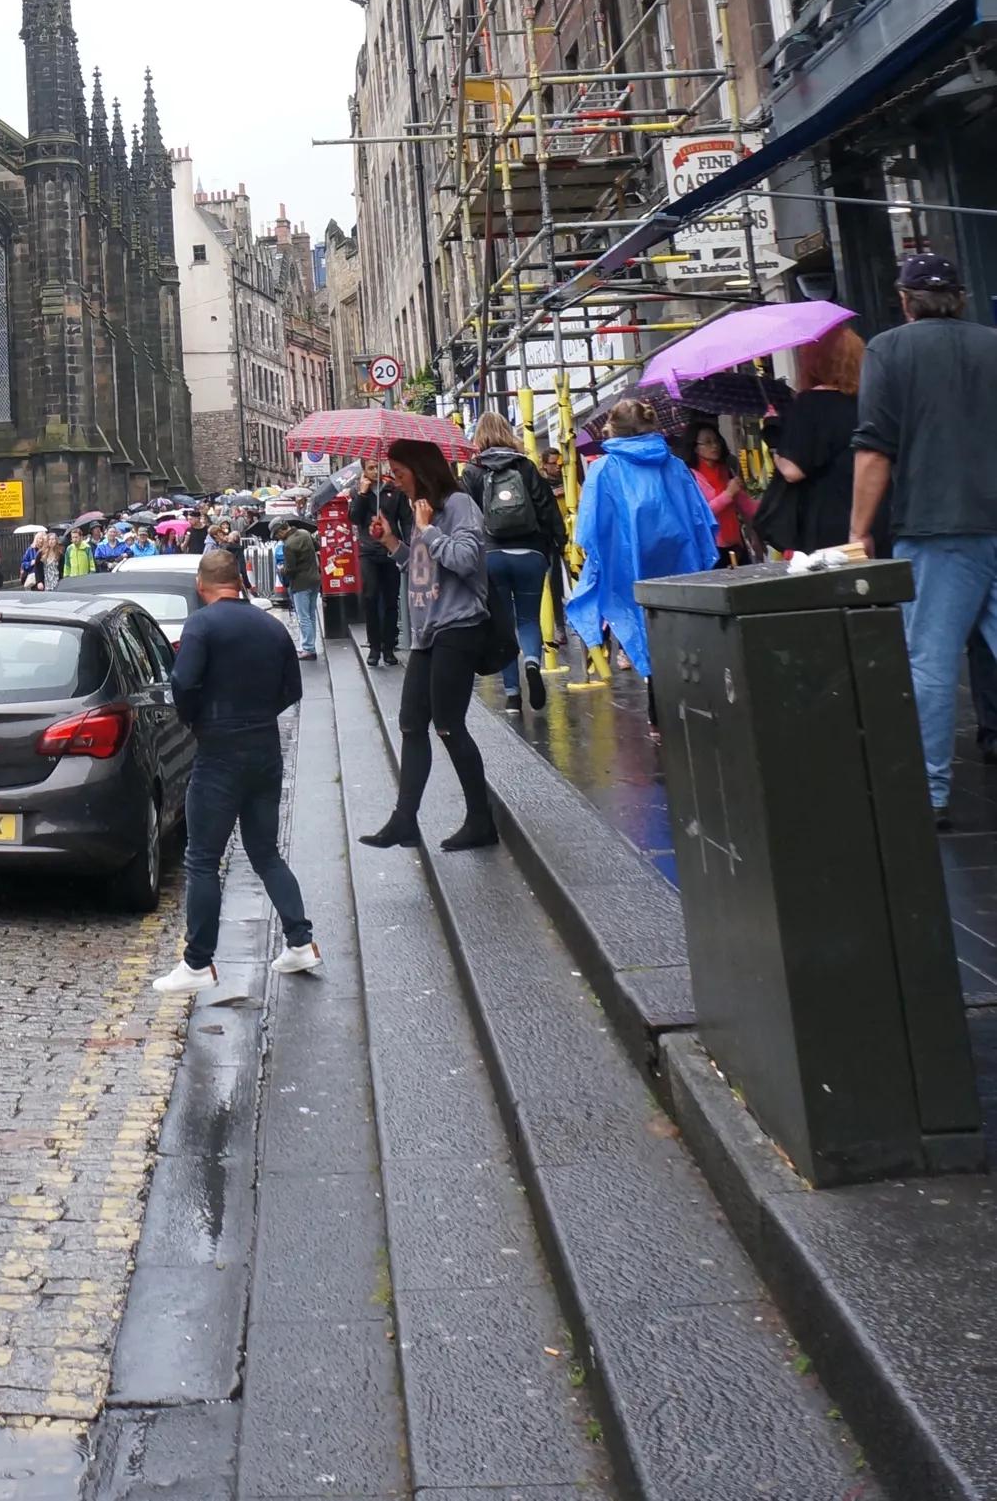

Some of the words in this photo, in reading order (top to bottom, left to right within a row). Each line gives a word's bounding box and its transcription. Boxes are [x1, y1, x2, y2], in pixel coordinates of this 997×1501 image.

[697, 155, 733, 170] FINE
[681, 209, 768, 234] OOLLNS
[679, 265, 699, 275] Tax
[700, 262, 740, 273] Refund
[374, 365, 396, 379] 20
